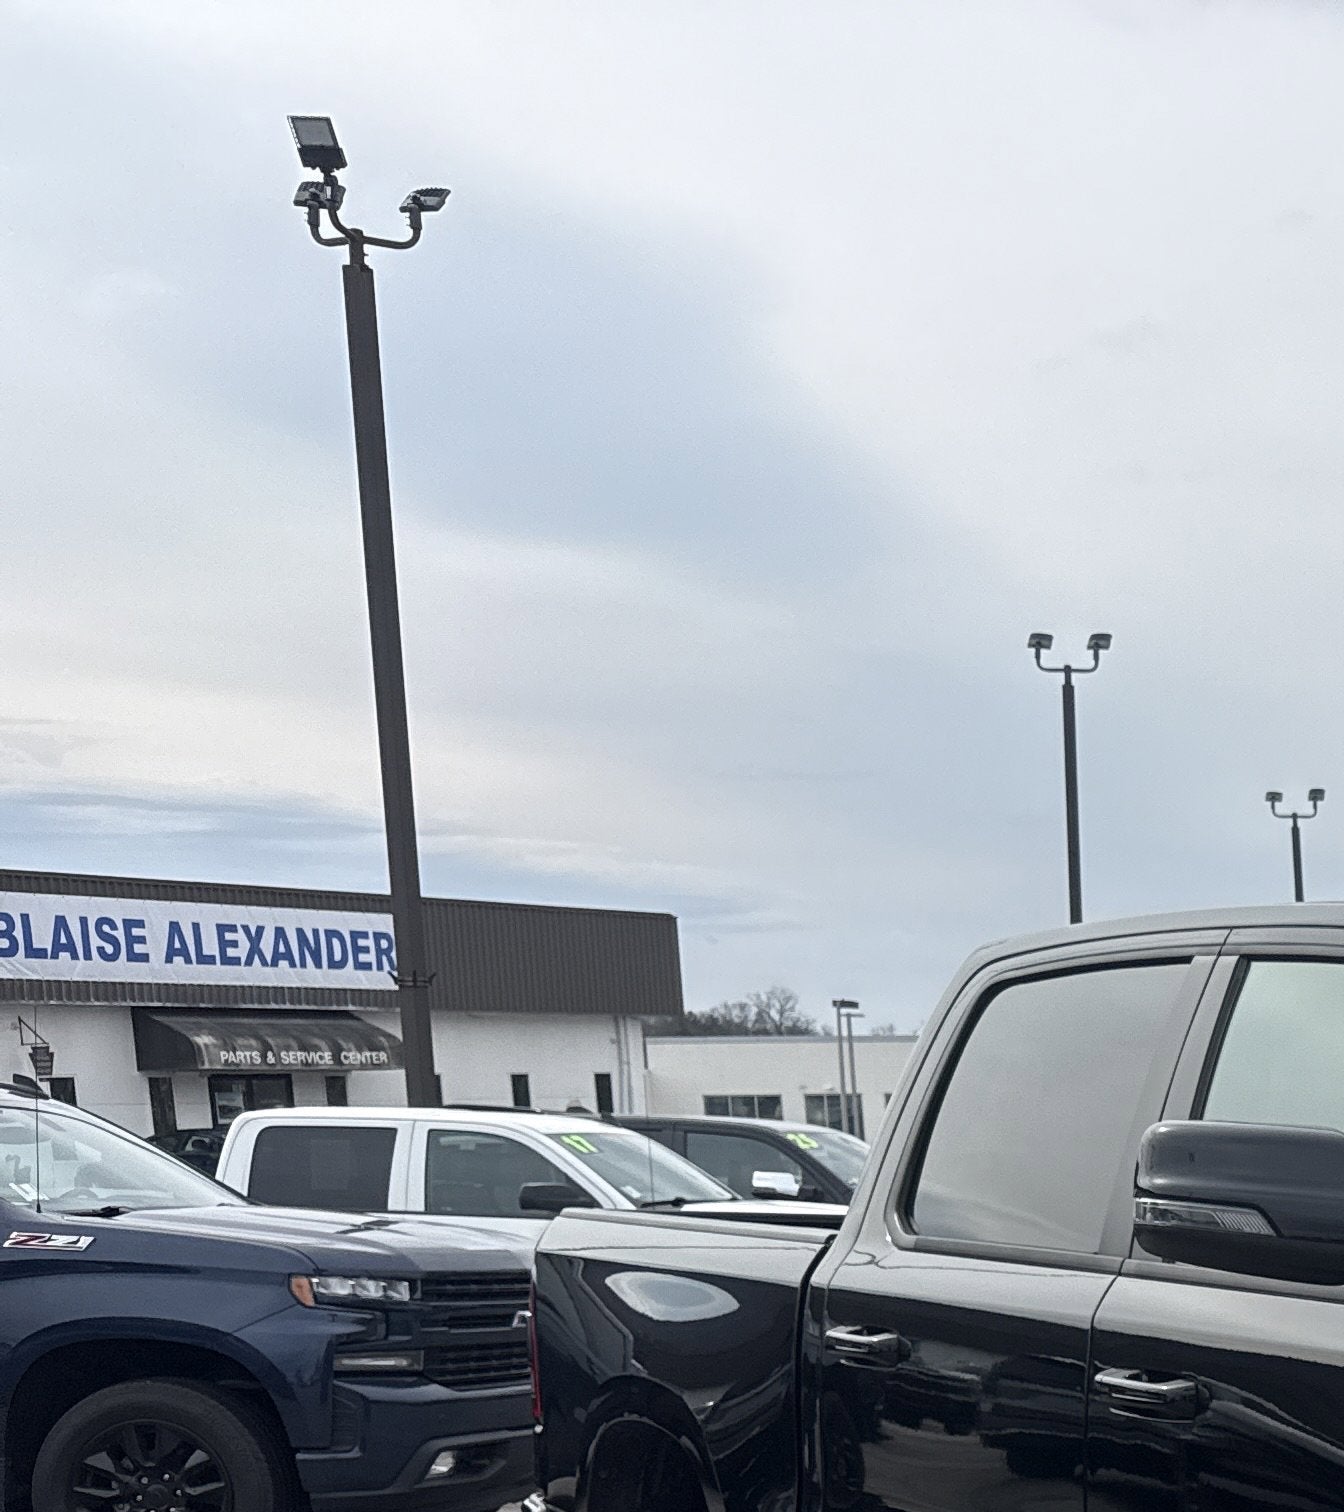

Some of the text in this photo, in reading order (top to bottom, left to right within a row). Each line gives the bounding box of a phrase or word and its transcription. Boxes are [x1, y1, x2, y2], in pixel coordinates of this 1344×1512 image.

[0, 912, 397, 972] BLAISE ALEXANDER
[220, 1050, 388, 1065] PARTS & SERVICE CENTER
[2, 1231, 95, 1251] Z71
